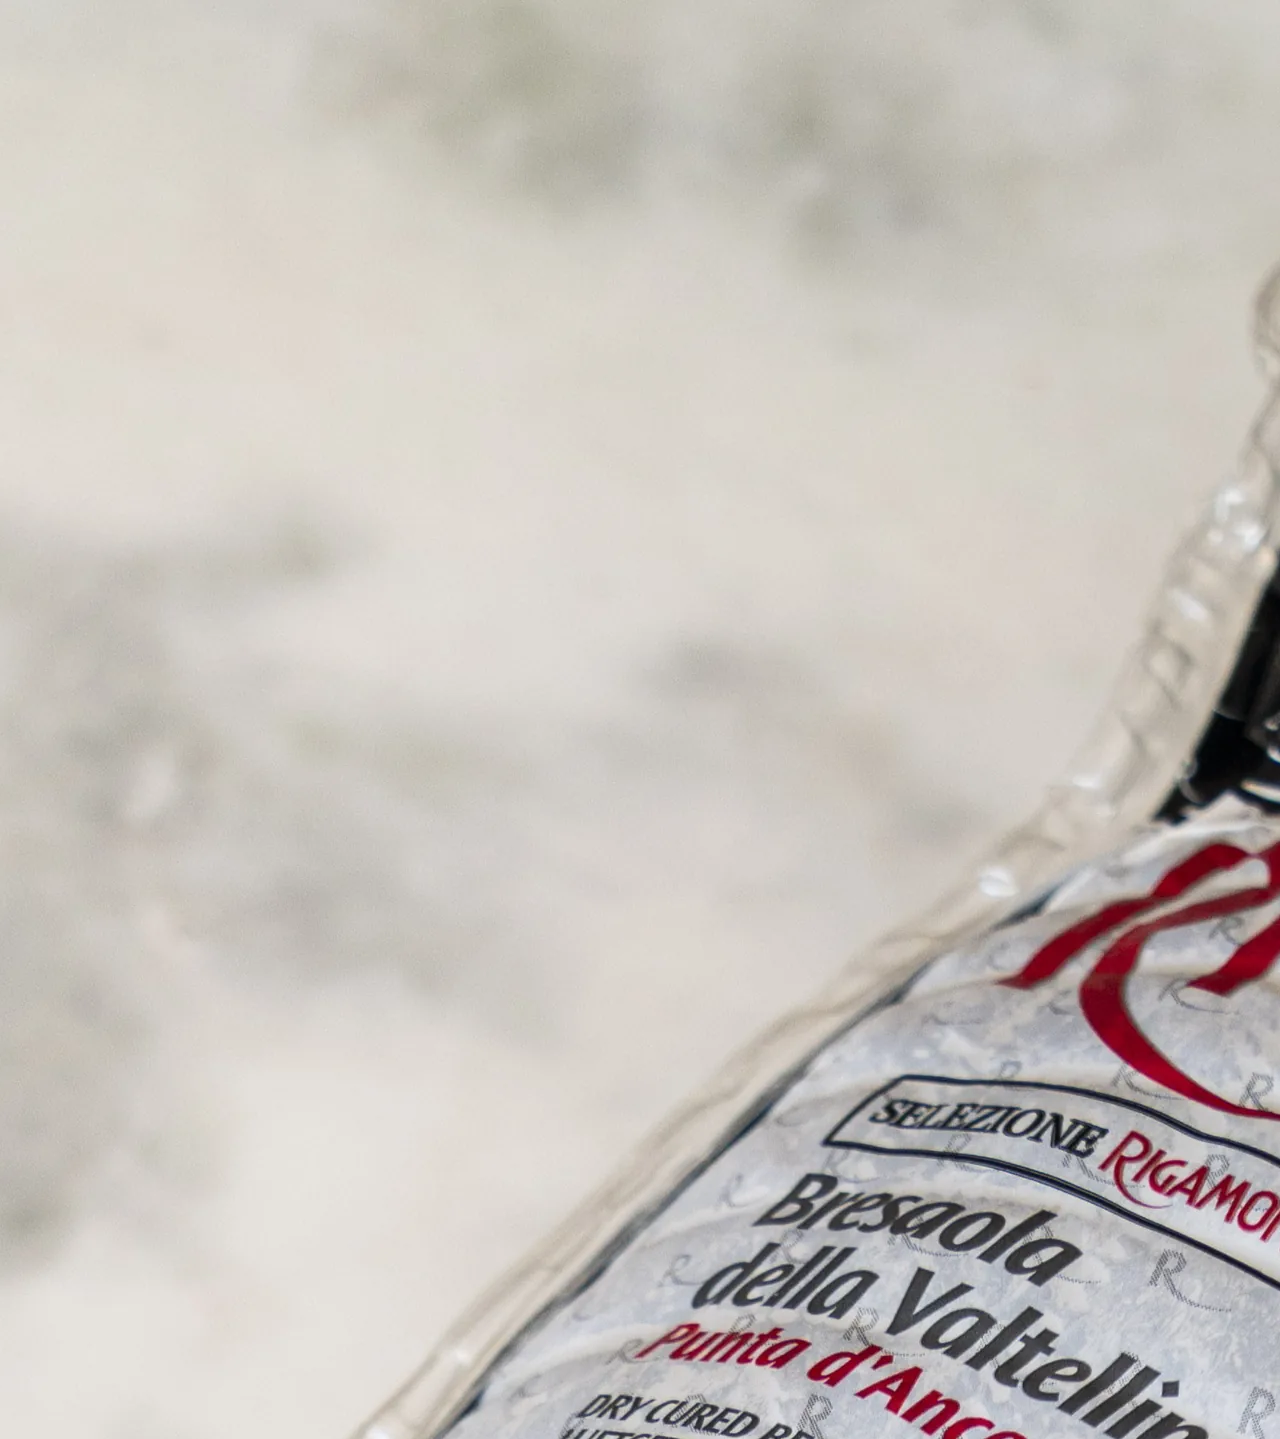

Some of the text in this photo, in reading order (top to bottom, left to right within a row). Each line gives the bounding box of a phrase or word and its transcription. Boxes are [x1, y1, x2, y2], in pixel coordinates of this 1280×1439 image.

[870, 1097, 1108, 1159] SELEZIONE
[752, 1173, 1083, 1288] Bresaola
[692, 1240, 879, 1317] della
[635, 1322, 804, 1368] Punta
[578, 1394, 641, 1423] DRY
[645, 1398, 760, 1437] CURED
